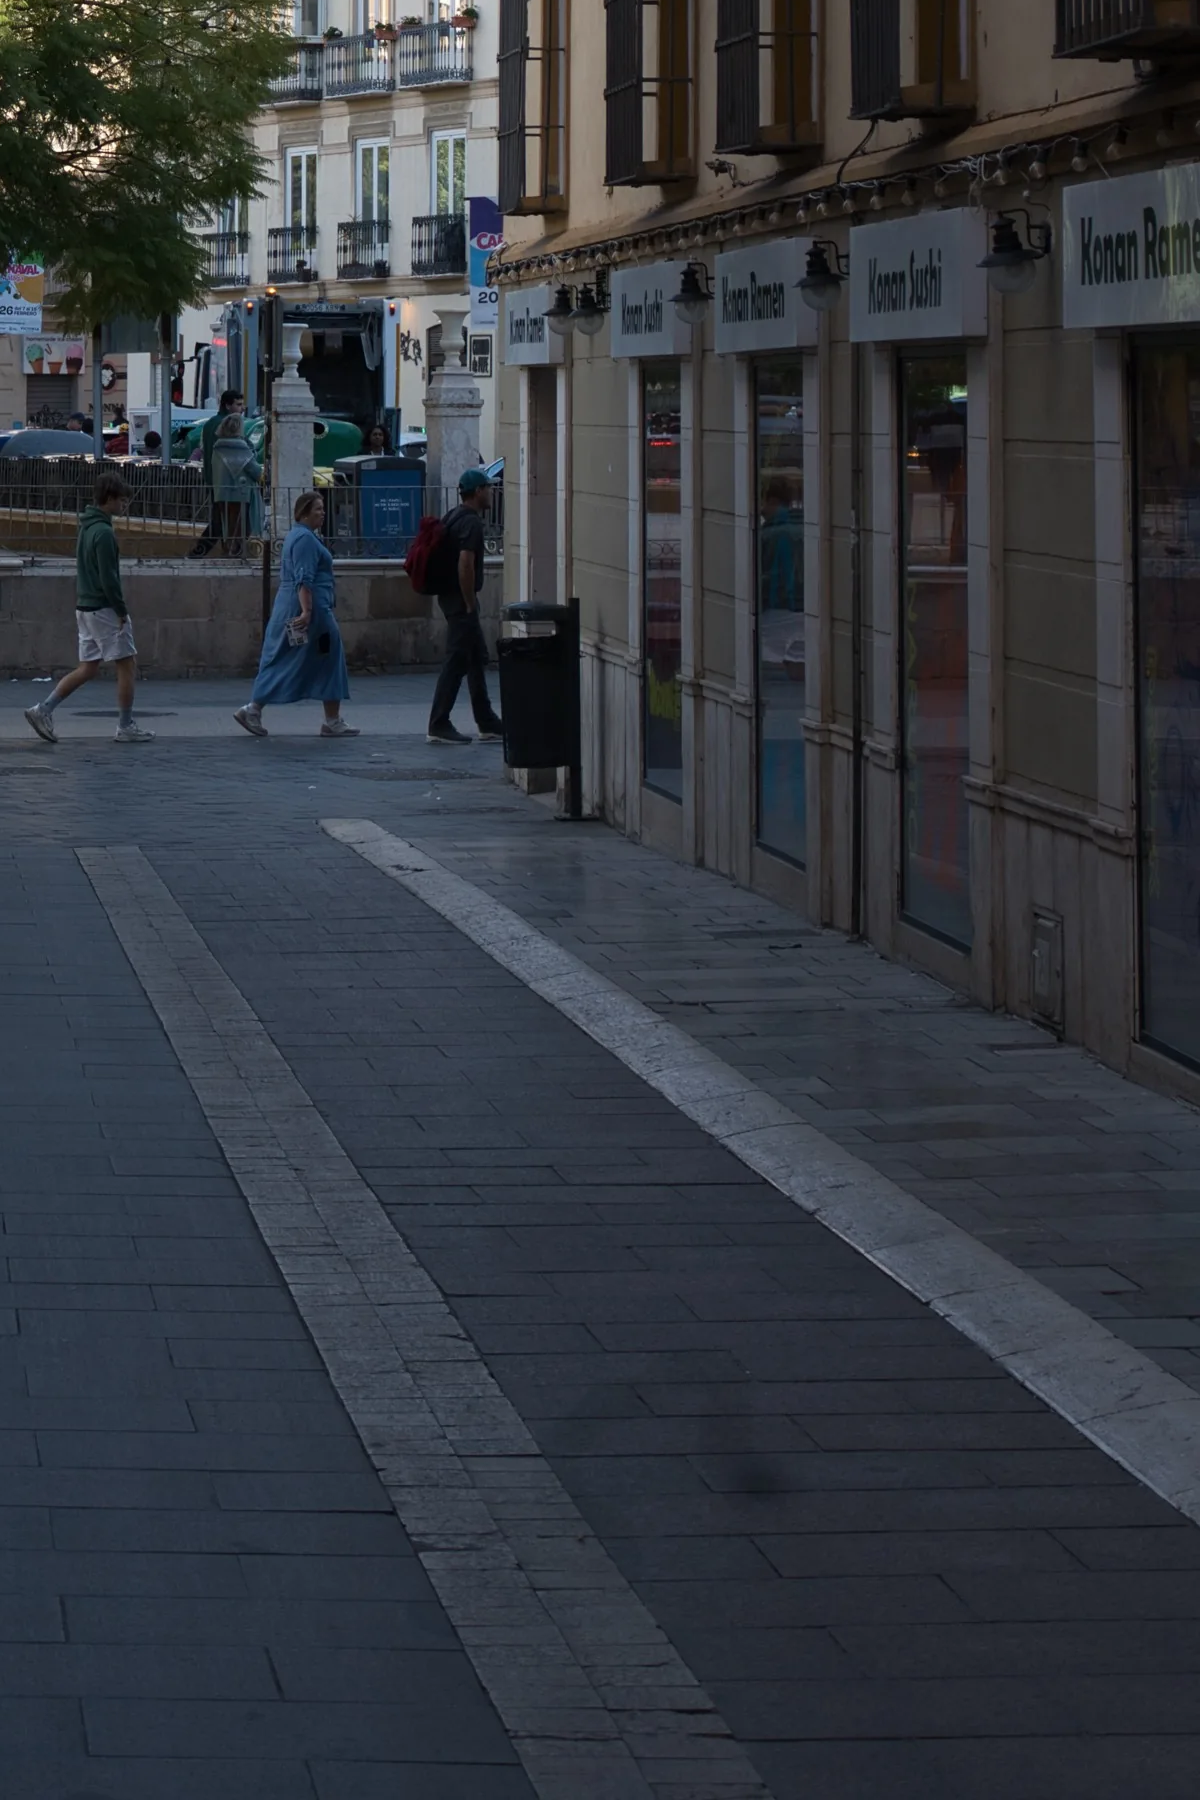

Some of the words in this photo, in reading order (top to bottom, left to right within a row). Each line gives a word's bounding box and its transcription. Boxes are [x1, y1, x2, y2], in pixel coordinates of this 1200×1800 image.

[1080, 216, 1138, 286] Konan
[722, 275, 749, 324] Konan
[750, 270, 785, 321] Ramen
[868, 257, 906, 314] Konan
[909, 247, 942, 311] Sushi
[509, 310, 525, 346] Konan
[526, 307, 545, 344] Ramen
[621, 292, 643, 336] Konan
[644, 288, 663, 335] Sushi
[88, 403, 126, 412] NNNA
